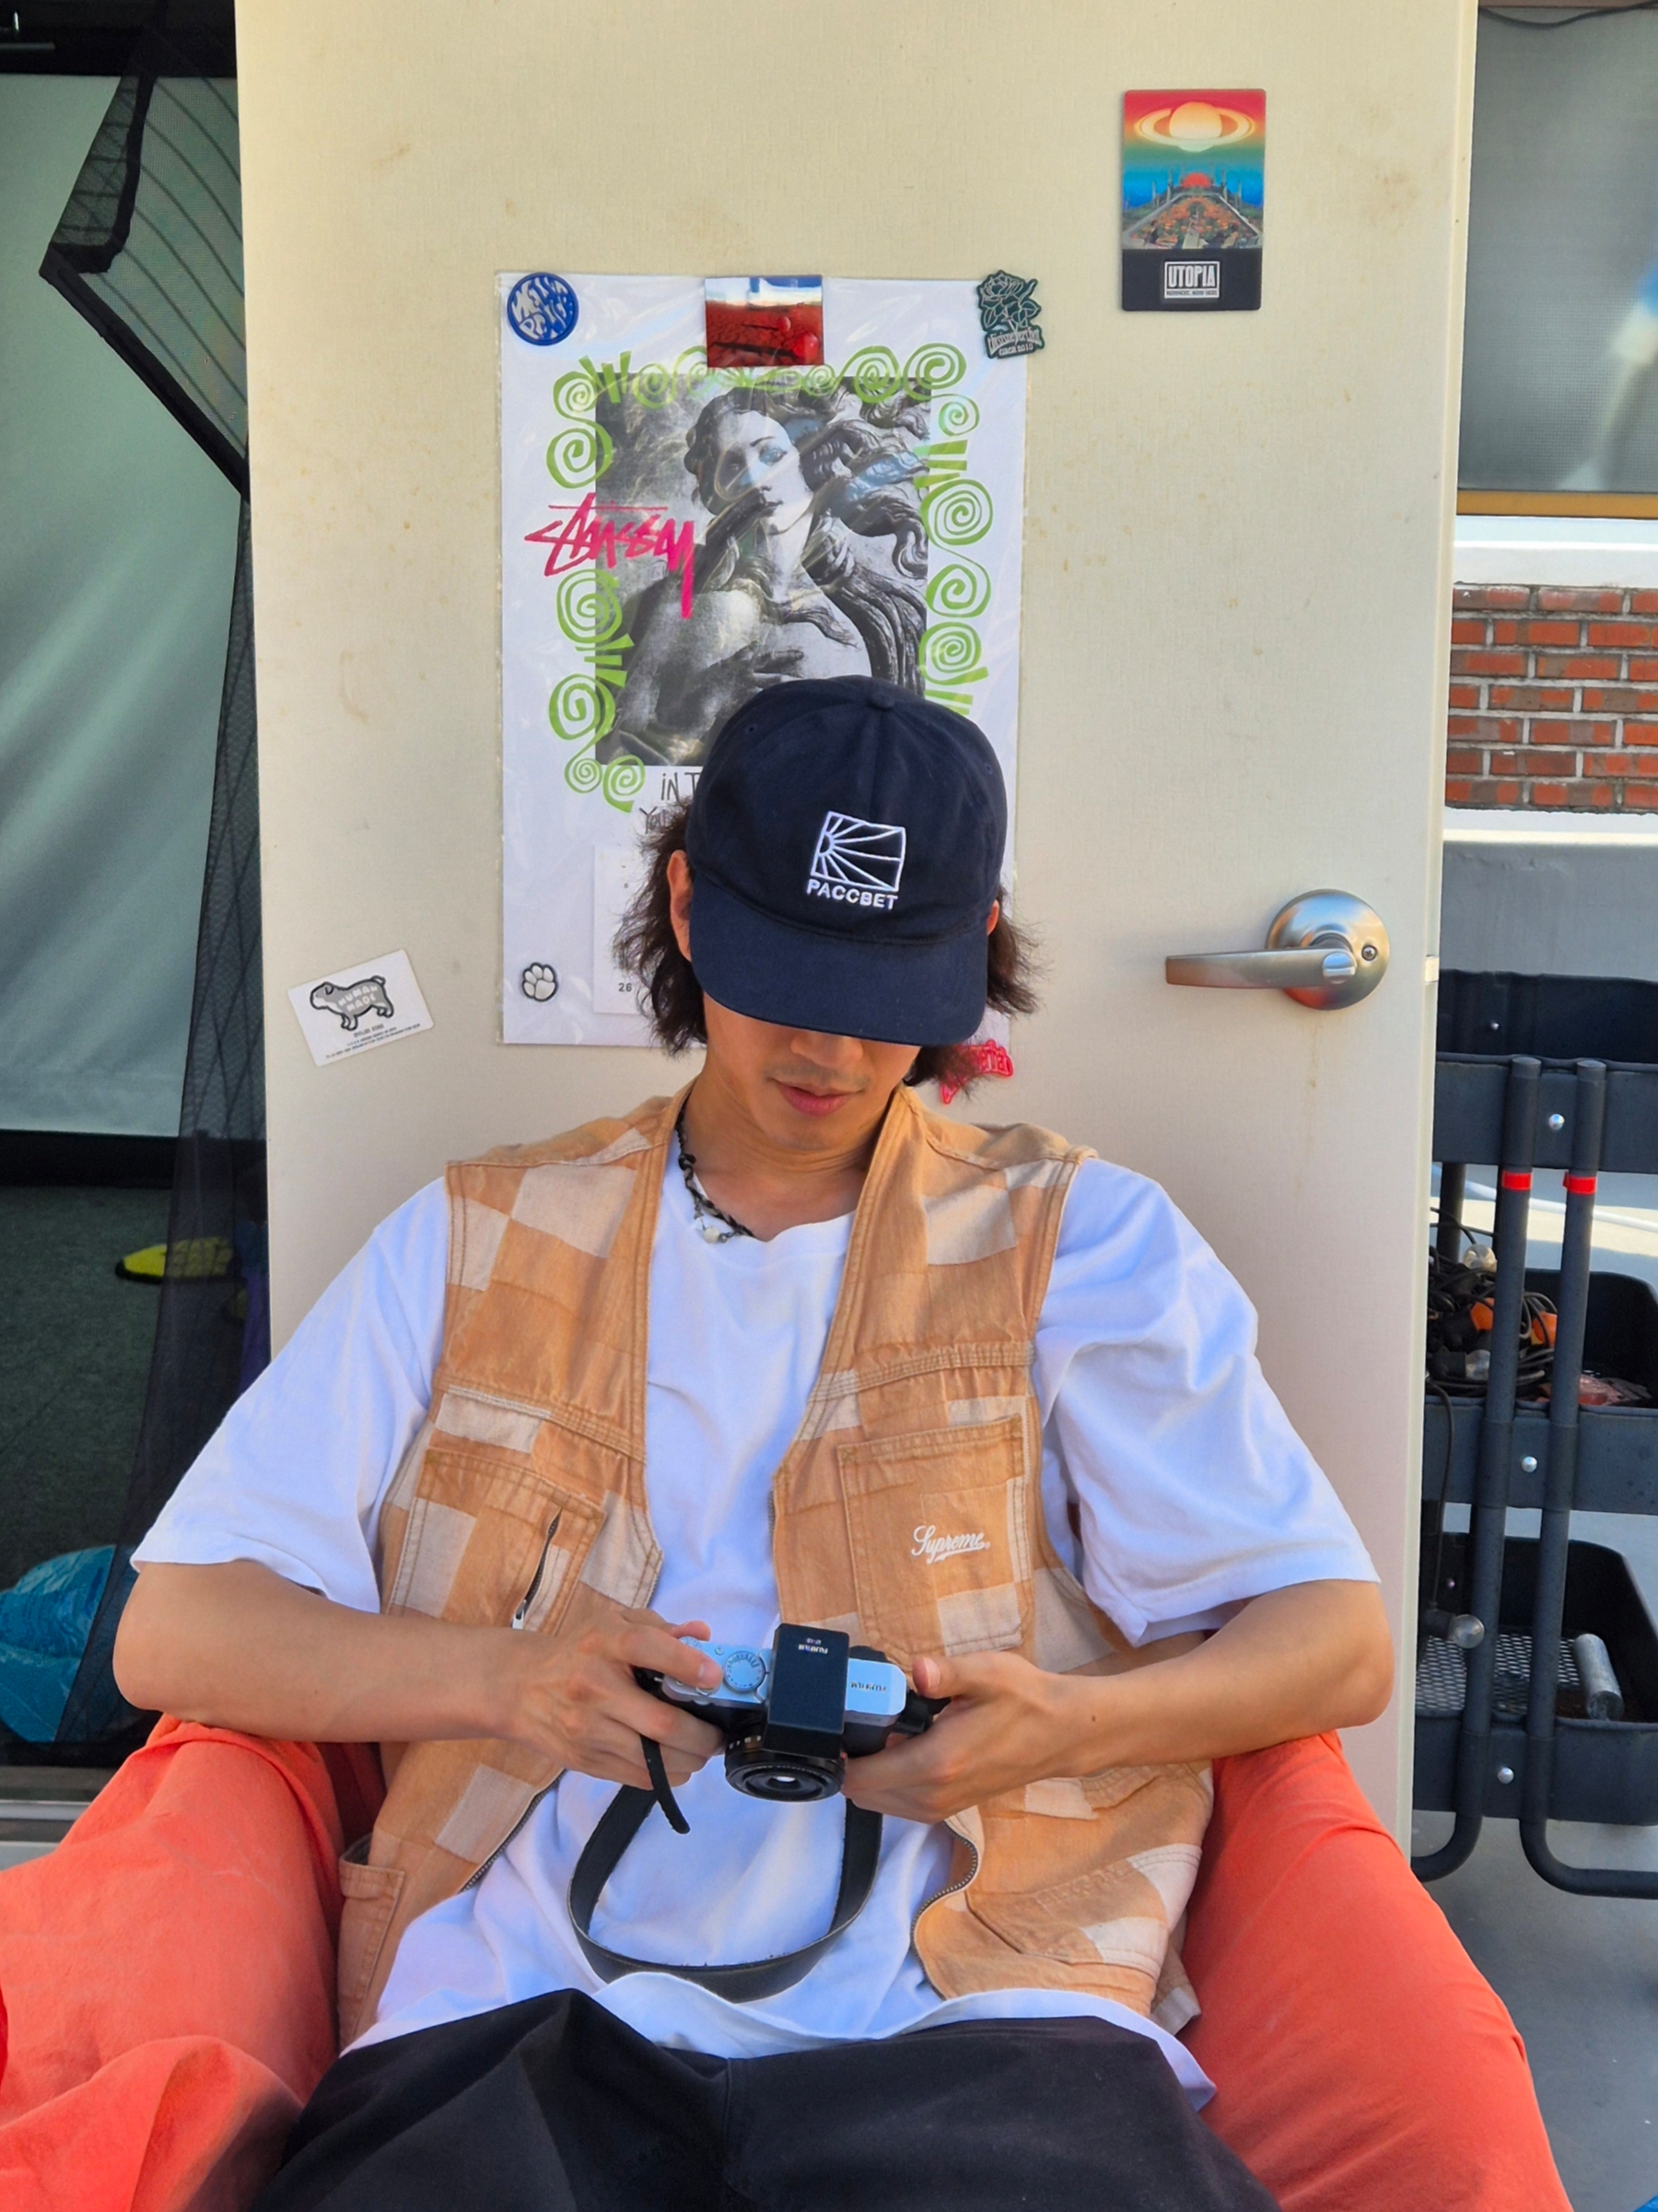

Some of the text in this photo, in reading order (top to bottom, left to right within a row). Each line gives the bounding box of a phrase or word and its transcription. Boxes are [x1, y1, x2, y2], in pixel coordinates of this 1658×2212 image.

[1168, 264, 1216, 288] UTOPIA
[806, 878, 899, 910] PACCBET
[337, 985, 379, 1007] HUMAN
[618, 982, 633, 993] 26
[346, 993, 377, 1012] MADE
[911, 1525, 987, 1565] Supreme
[798, 1644, 829, 1655] FUJIFILM
[850, 1681, 887, 1692] FUJIFILM
